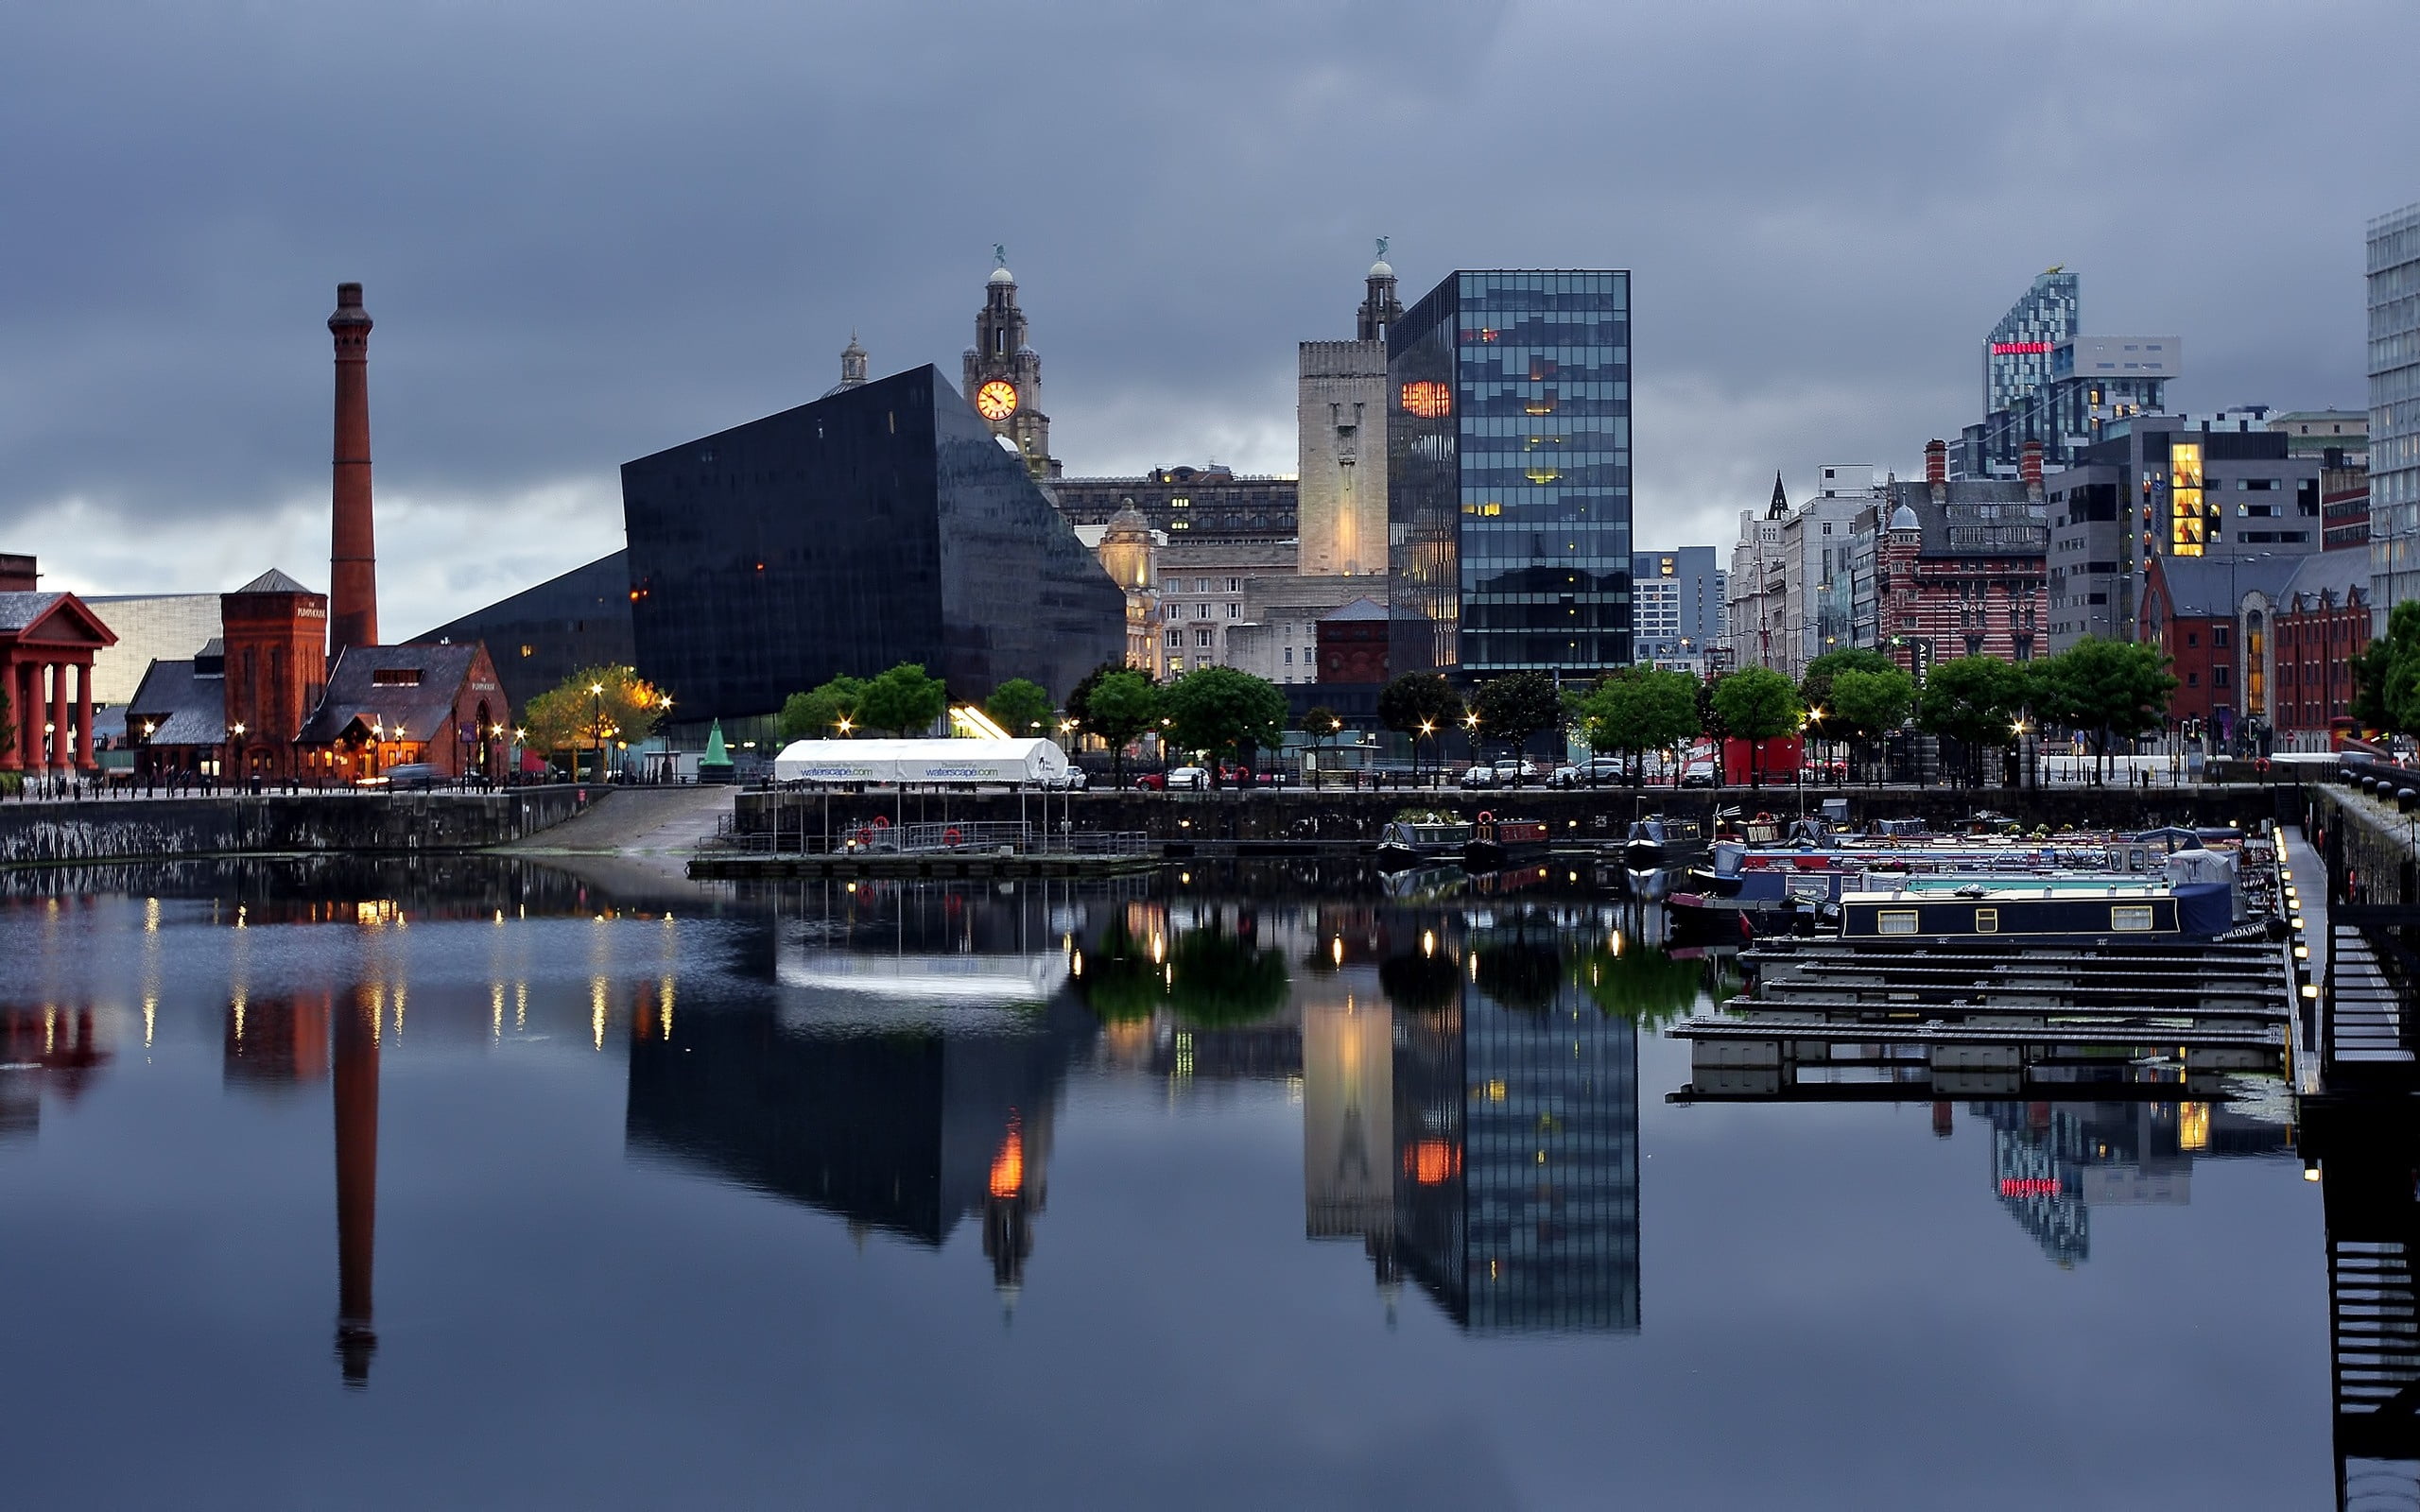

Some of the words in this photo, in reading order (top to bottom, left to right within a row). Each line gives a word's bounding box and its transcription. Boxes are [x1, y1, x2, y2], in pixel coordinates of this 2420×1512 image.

[1919, 644, 1927, 691] ALBERT
[801, 767, 873, 777] waterscape.com
[925, 767, 998, 778] waterscape.com
